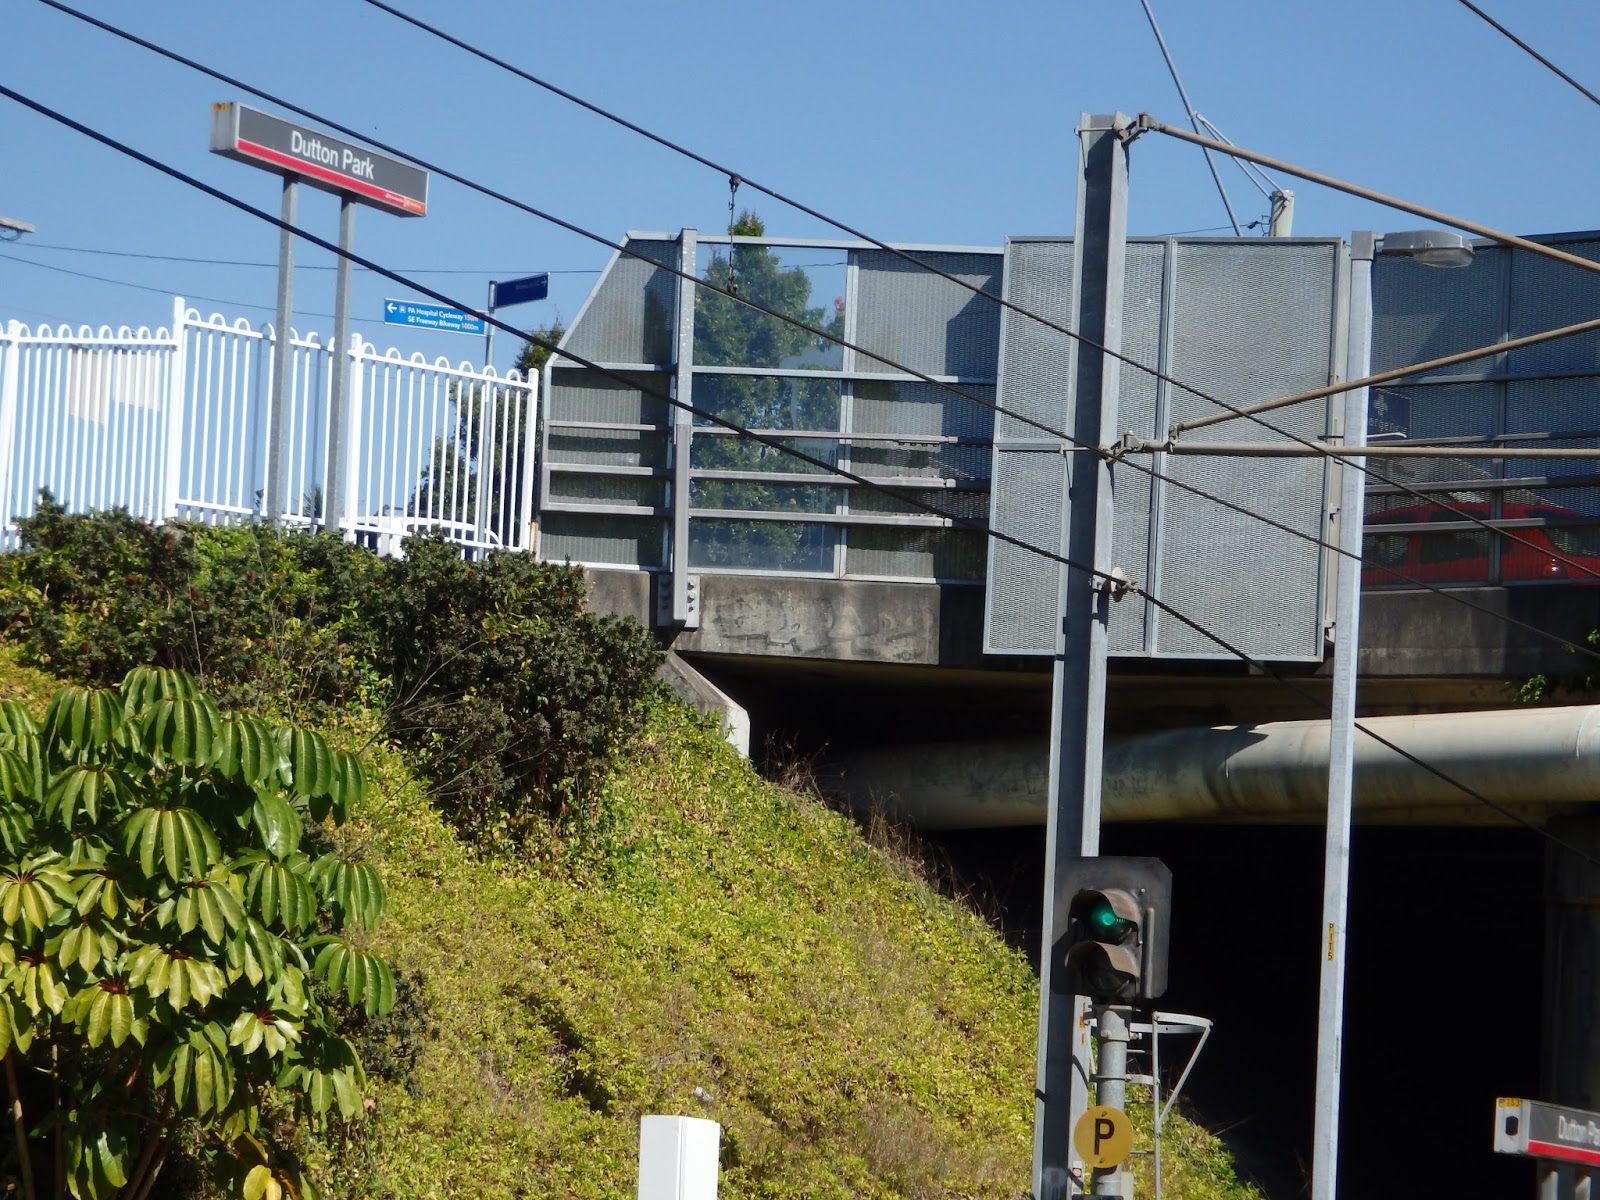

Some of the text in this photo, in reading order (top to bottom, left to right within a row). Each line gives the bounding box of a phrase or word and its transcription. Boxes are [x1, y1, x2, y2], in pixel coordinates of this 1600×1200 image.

[291, 130, 375, 180] Dutton Park
[407, 306, 416, 314] PA
[416, 307, 438, 319] Hospital
[438, 310, 464, 322] Cycleway
[407, 315, 479, 331] SE Freeway Bikeway 1000m
[1094, 1118, 1115, 1156] P
